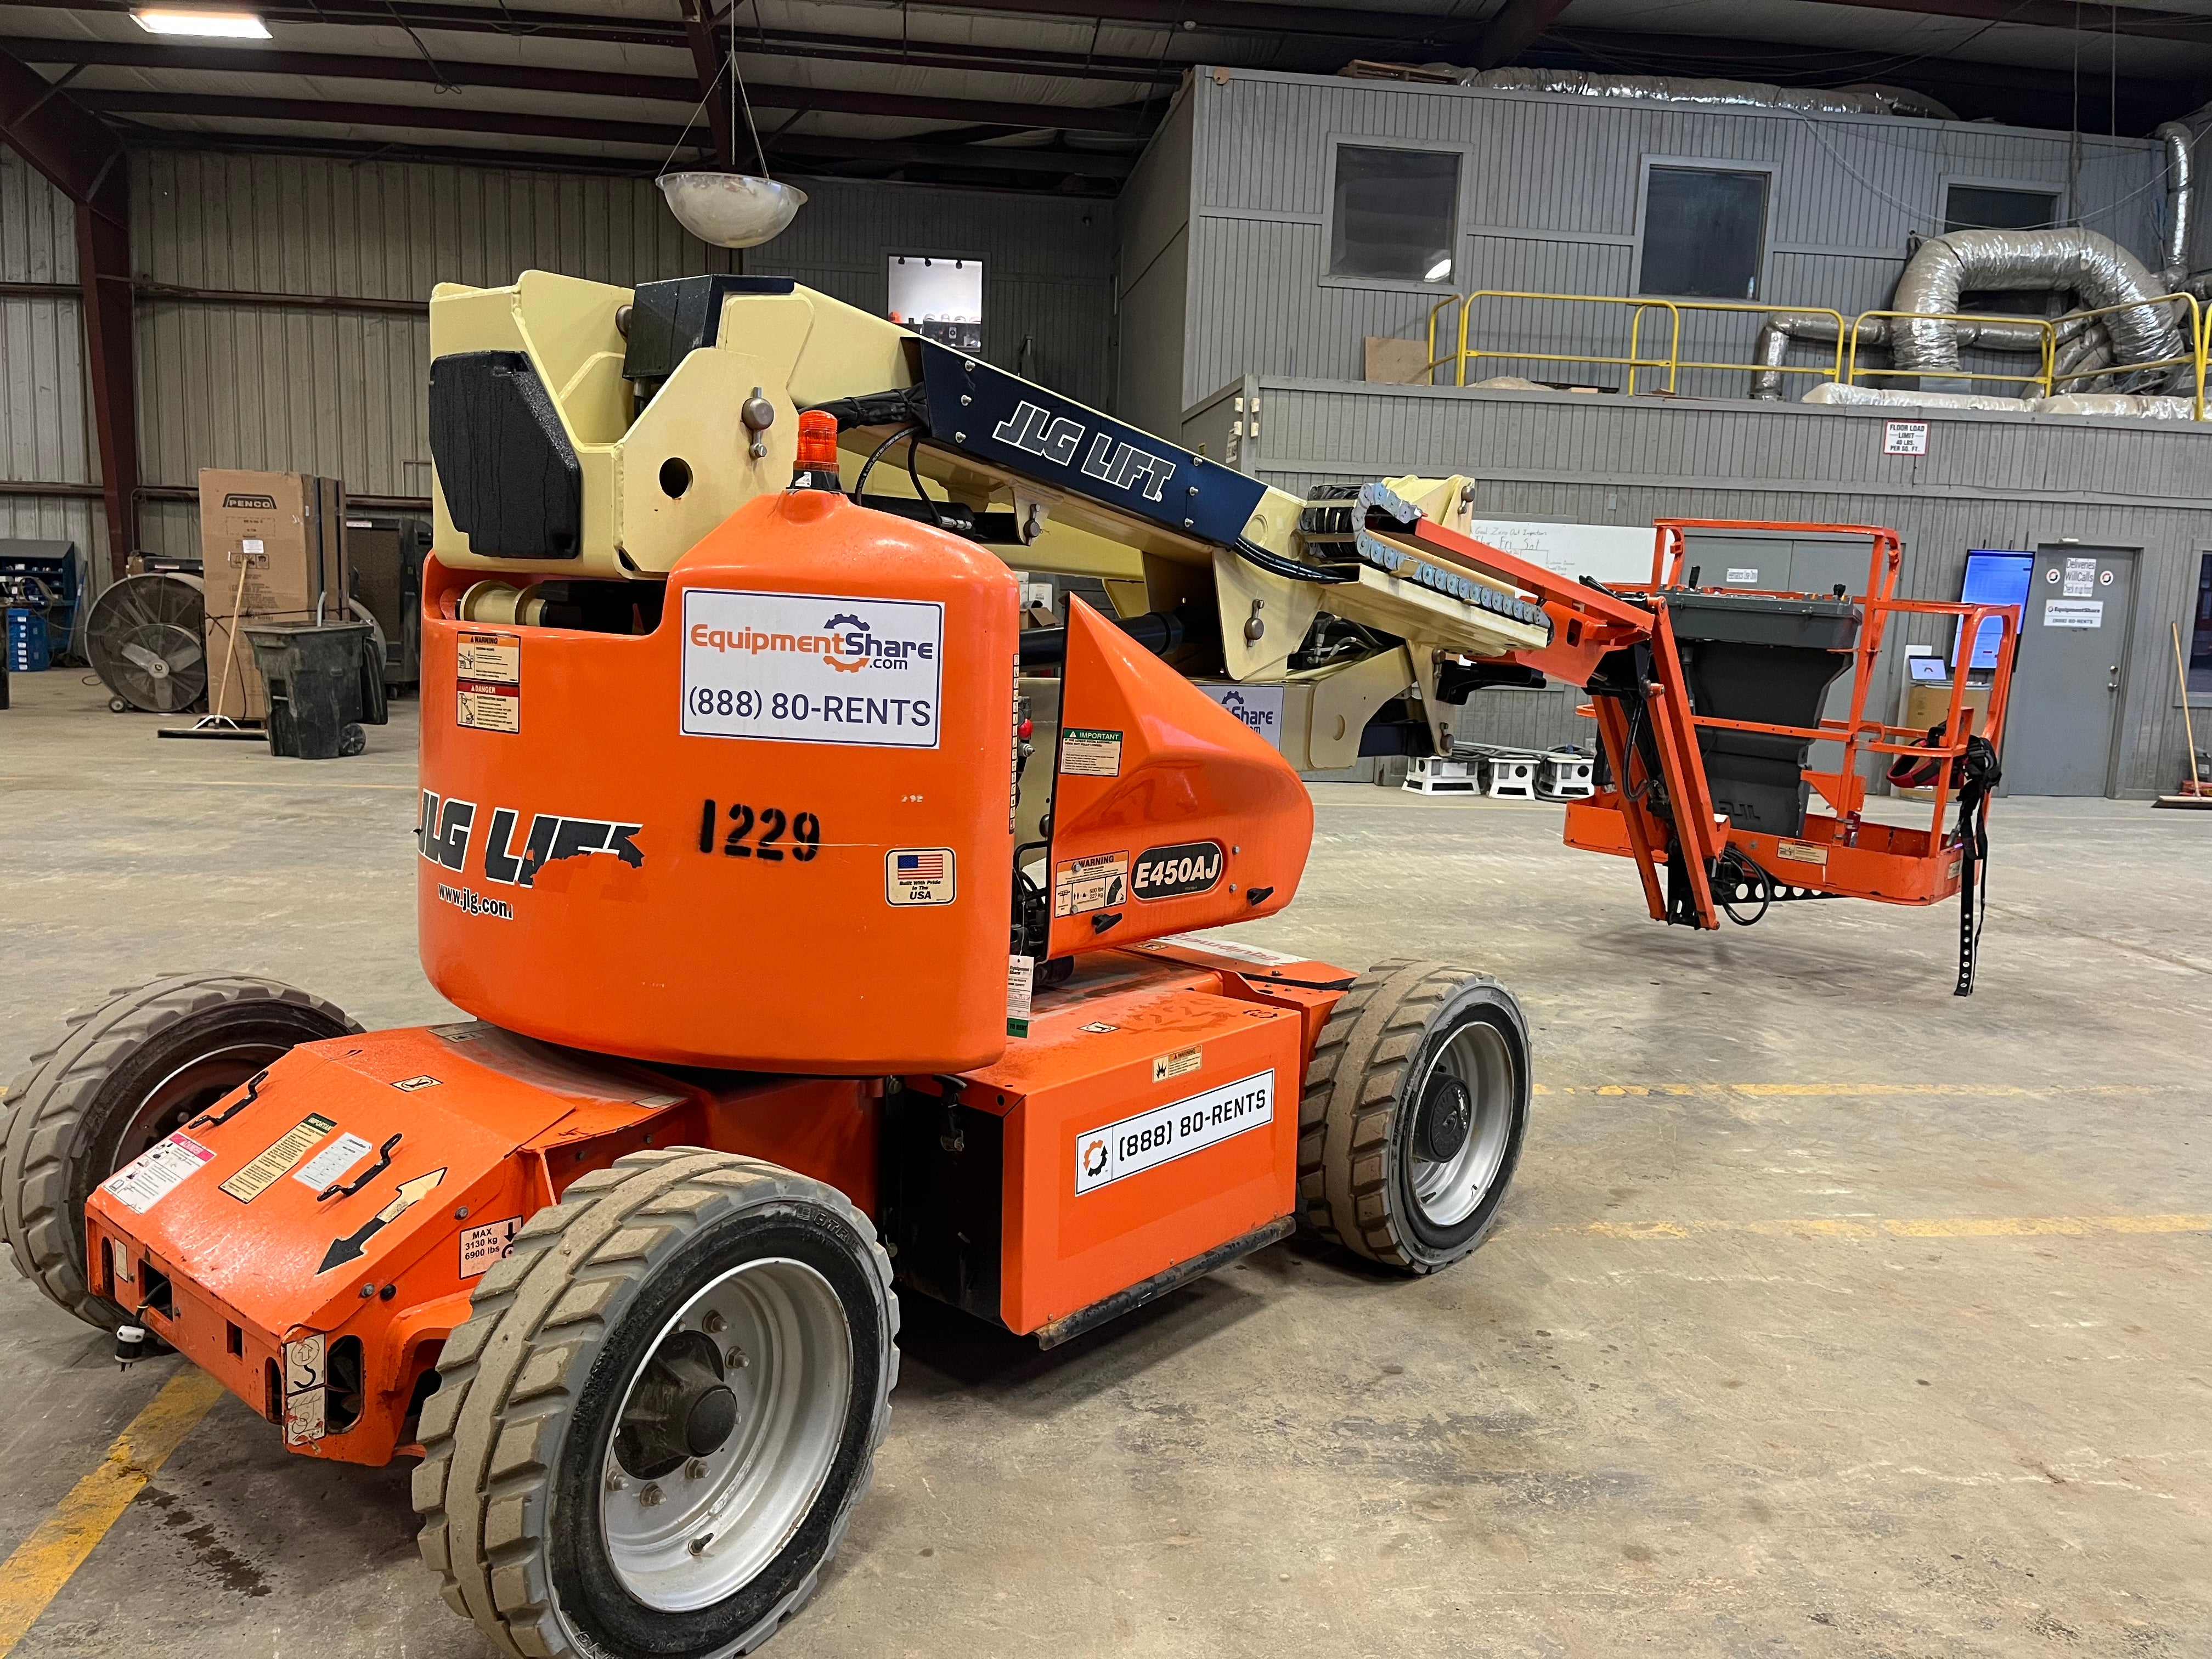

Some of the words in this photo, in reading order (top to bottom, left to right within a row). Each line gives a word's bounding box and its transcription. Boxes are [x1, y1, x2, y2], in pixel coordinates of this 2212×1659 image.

[992, 400, 1086, 466] JLG
[1081, 432, 1176, 501] LIFT
[229, 499, 271, 508] PENCO
[475, 636, 498, 644] WARNING
[691, 624, 933, 660] EquipmentShare
[869, 658, 907, 670] .com
[475, 686, 496, 694] DANGER
[689, 686, 762, 720] (888)
[771, 693, 931, 726] 80-RENTS
[1227, 706, 1273, 725] Share
[1079, 732, 1119, 740] IMPORTANT
[699, 799, 821, 862] 1229
[1079, 855, 1114, 868] WARNING
[1134, 854, 1220, 889] E450AJ
[910, 891, 932, 900] USA
[1119, 1120, 1172, 1162] (888)
[1180, 1089, 1266, 1138] 80-RENTS
[472, 1228, 492, 1240] MAX
[465, 1239, 485, 1250] 3130
[465, 1249, 485, 1260] 6900
[487, 1246, 500, 1255] lbs
